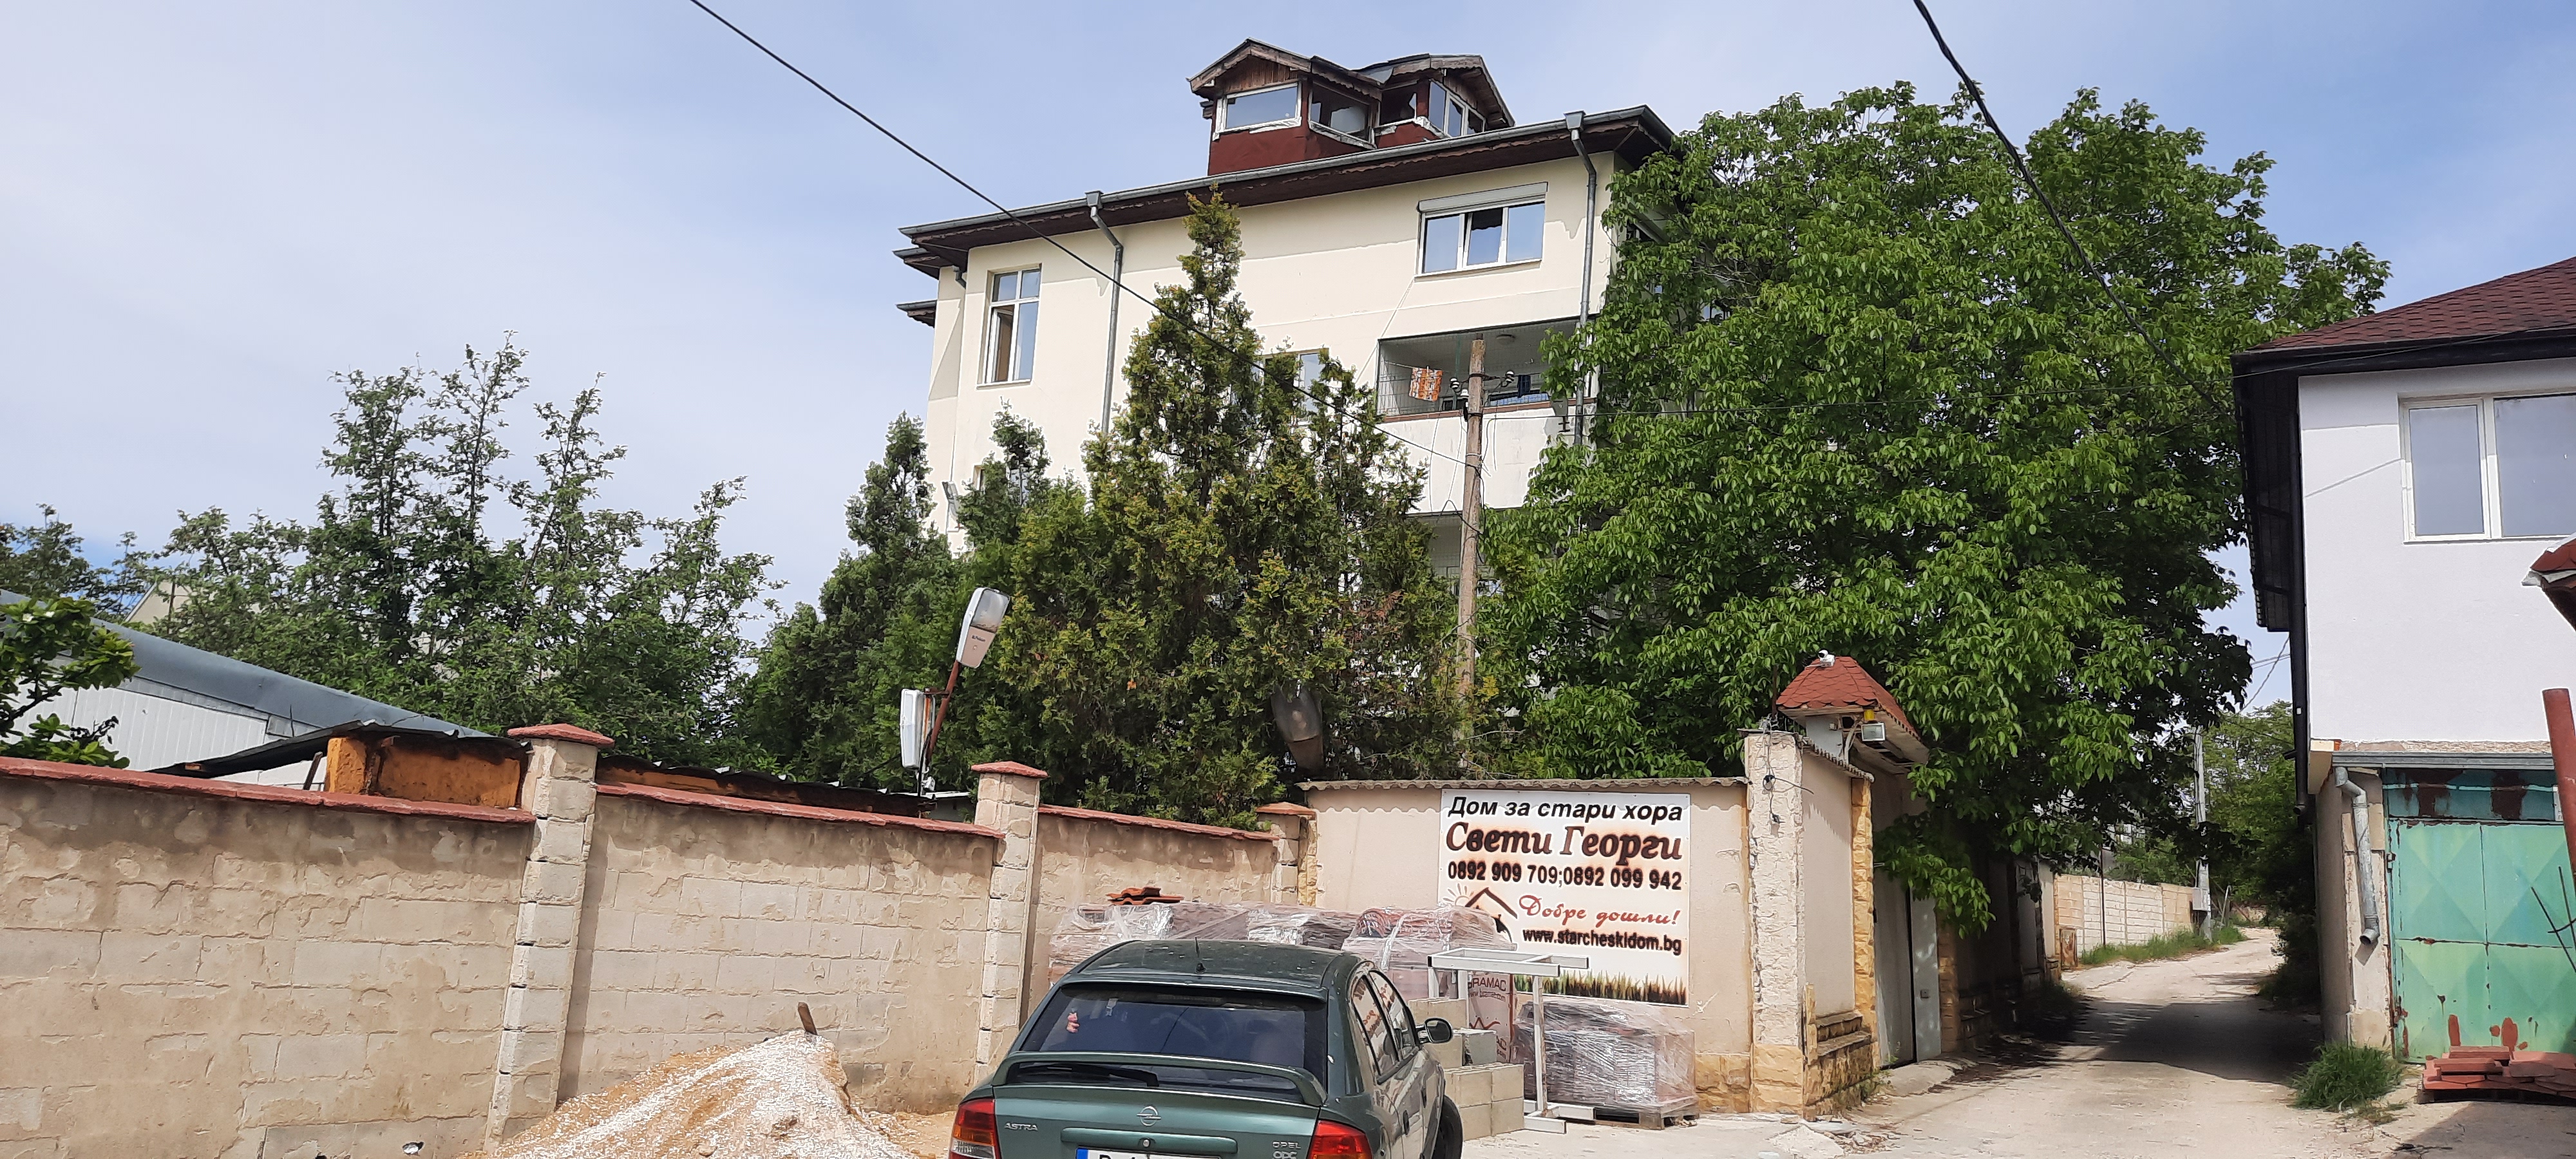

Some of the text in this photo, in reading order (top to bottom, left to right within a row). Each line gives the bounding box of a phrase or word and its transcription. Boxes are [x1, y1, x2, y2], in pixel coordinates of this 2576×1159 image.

[1448, 796, 1683, 825] Дом за стари хора
[1446, 821, 1683, 866] Свети Георги
[1448, 861, 1486, 881] 0892
[1492, 862, 1522, 882] 909
[1610, 867, 1643, 889] 099
[1649, 869, 1682, 890] 942
[1519, 895, 1681, 928] Добре дошли!
[1522, 928, 1682, 956] www.starcheskidom.bg
[1005, 1122, 1038, 1131] ASTRA
